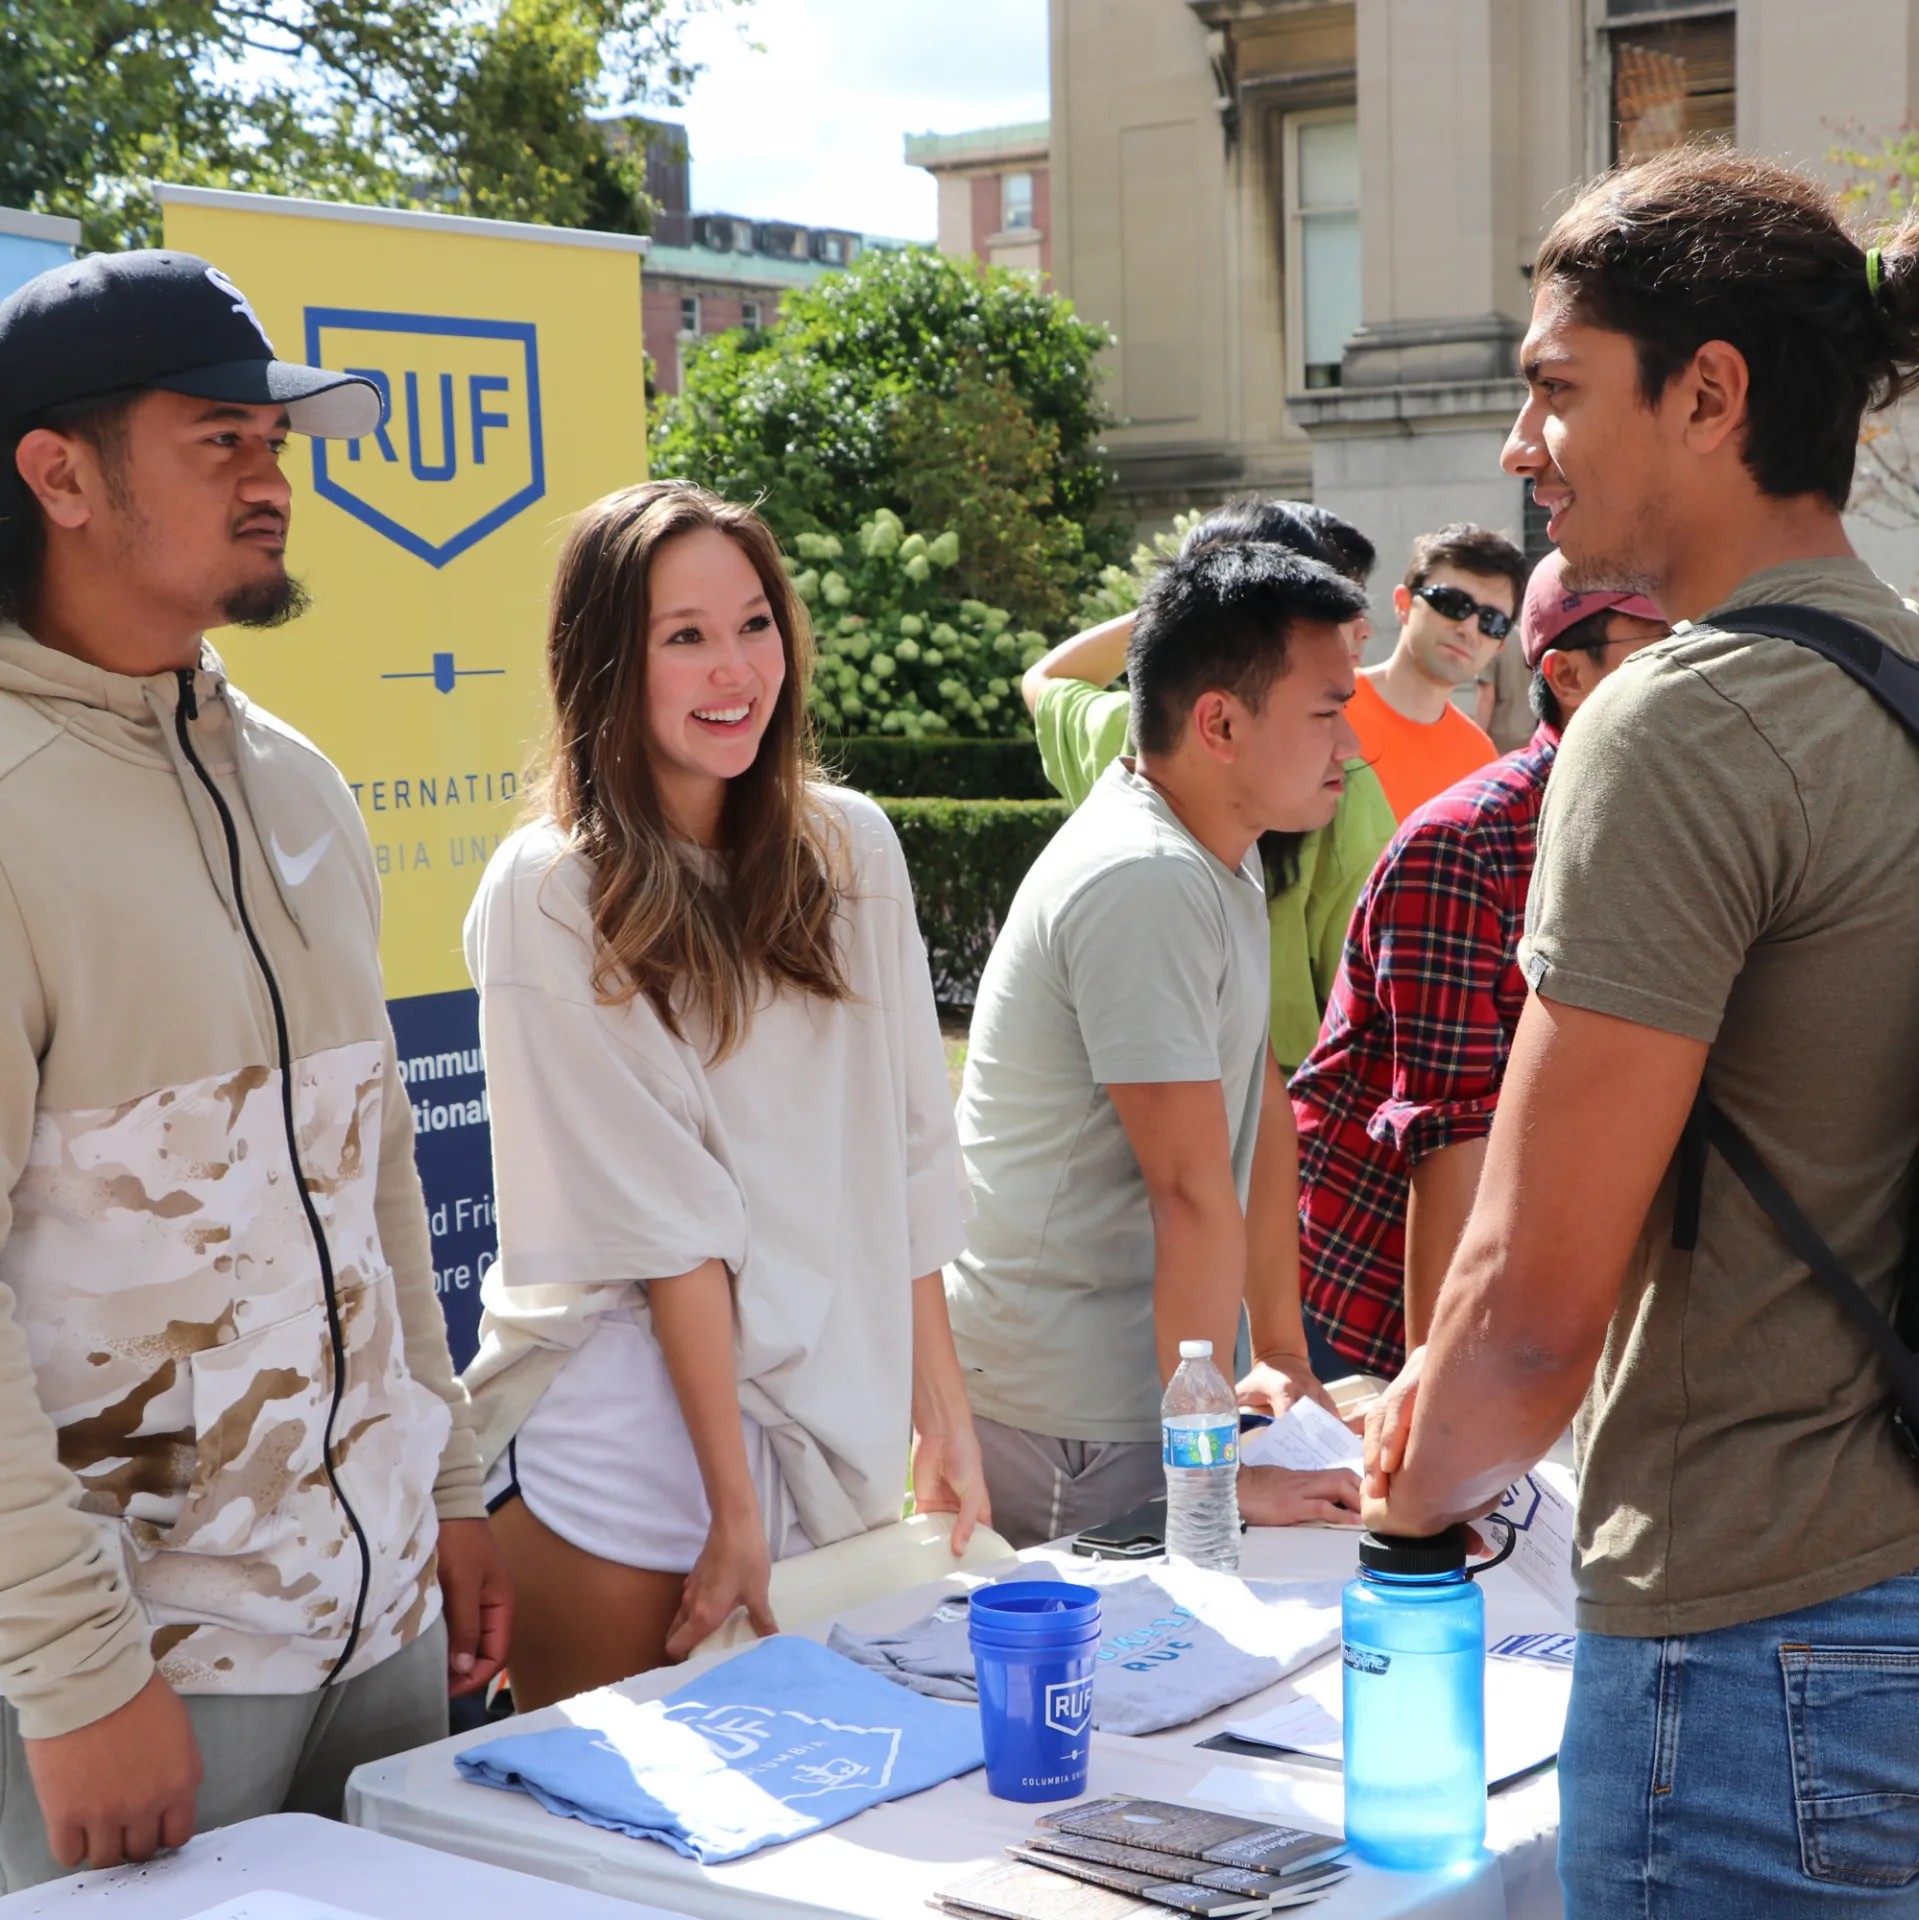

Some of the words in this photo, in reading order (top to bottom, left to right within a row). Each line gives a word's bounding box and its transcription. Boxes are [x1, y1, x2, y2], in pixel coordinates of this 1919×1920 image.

[343, 367, 509, 482] RUF
[350, 771, 535, 811] TERNATIO
[426, 1202, 448, 1236] d
[1055, 1686, 1093, 1719] RUF
[1021, 1773, 1069, 1787] COLUMBIA
